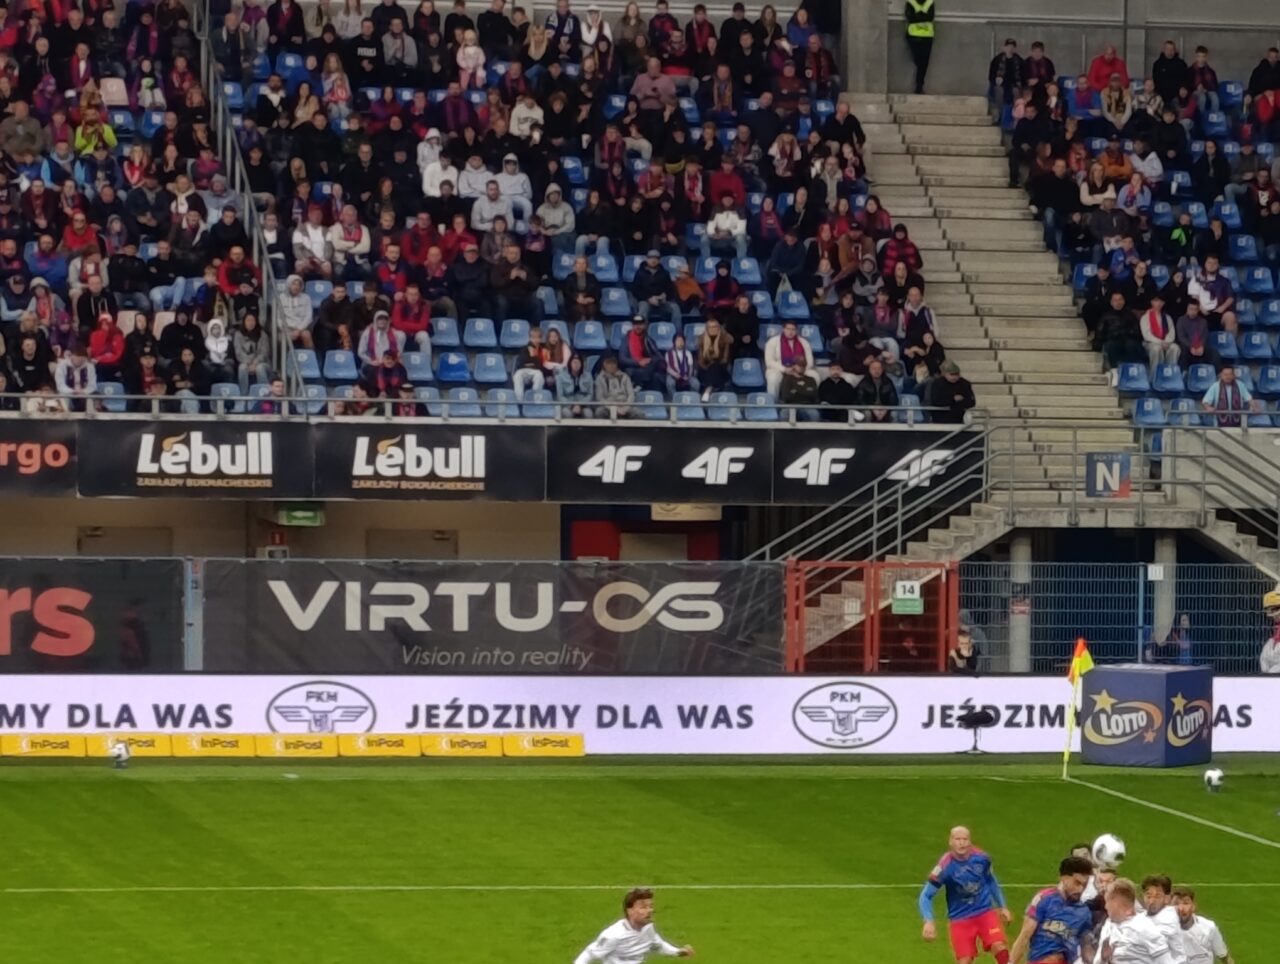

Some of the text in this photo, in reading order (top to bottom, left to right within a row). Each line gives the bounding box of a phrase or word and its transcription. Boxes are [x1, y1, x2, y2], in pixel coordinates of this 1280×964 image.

[578, 445, 651, 484] 4F
[681, 446, 754, 485] 4F
[783, 448, 855, 486] 4F
[885, 449, 955, 487] 4F
[1096, 462, 1120, 491] N
[901, 584, 915, 595] 14
[402, 644, 593, 671] Vision into reality
[830, 692, 861, 703] PKM
[67, 703, 137, 728] DLA
[153, 703, 233, 729] WAS
[405, 697, 754, 729] JEŹDZIMY DLA WAS
[922, 697, 1081, 729] JEŹDZIM
[1100, 711, 1147, 735] LOTTO
[1176, 708, 1204, 738] LOTTO
[1213, 704, 1253, 728] AS
[31, 739, 70, 750] InPost
[201, 738, 239, 749] InPost
[284, 740, 322, 750] InPost
[367, 738, 404, 748] InPost
[450, 739, 487, 750] InPost
[532, 737, 570, 748] InPost
